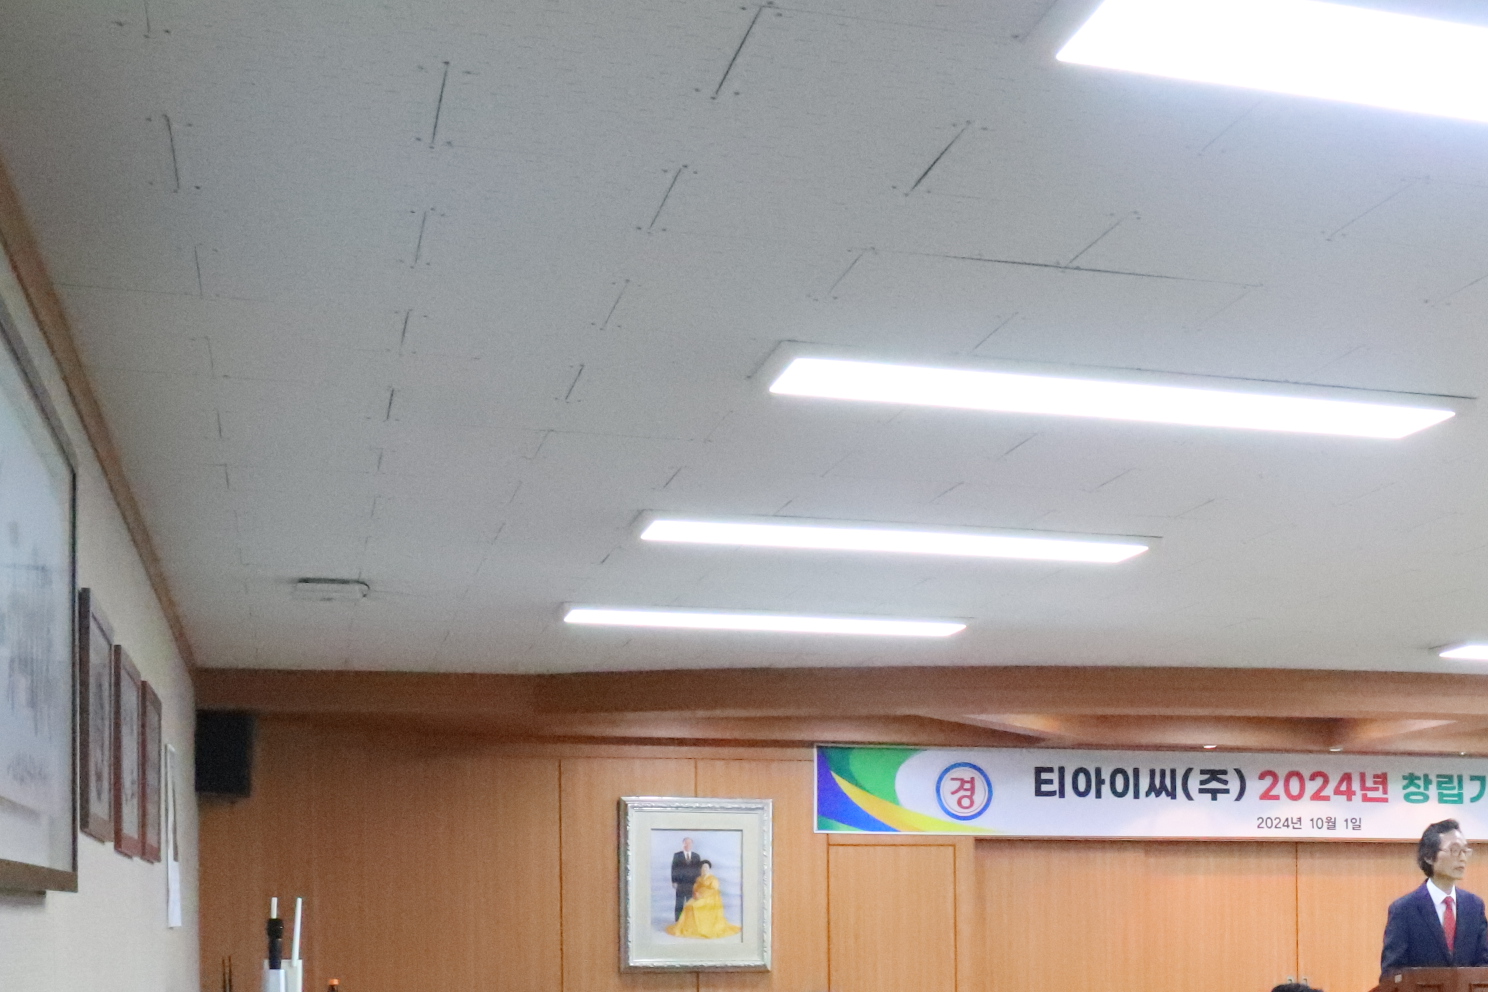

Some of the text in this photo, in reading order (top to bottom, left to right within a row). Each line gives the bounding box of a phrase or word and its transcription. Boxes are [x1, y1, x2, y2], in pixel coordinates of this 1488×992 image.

[949, 775, 977, 810] 경
[1033, 765, 1247, 802] 티아이씨(주)
[1257, 769, 1390, 804] 2024년
[1256, 816, 1362, 831] 2024년 10월 1일
